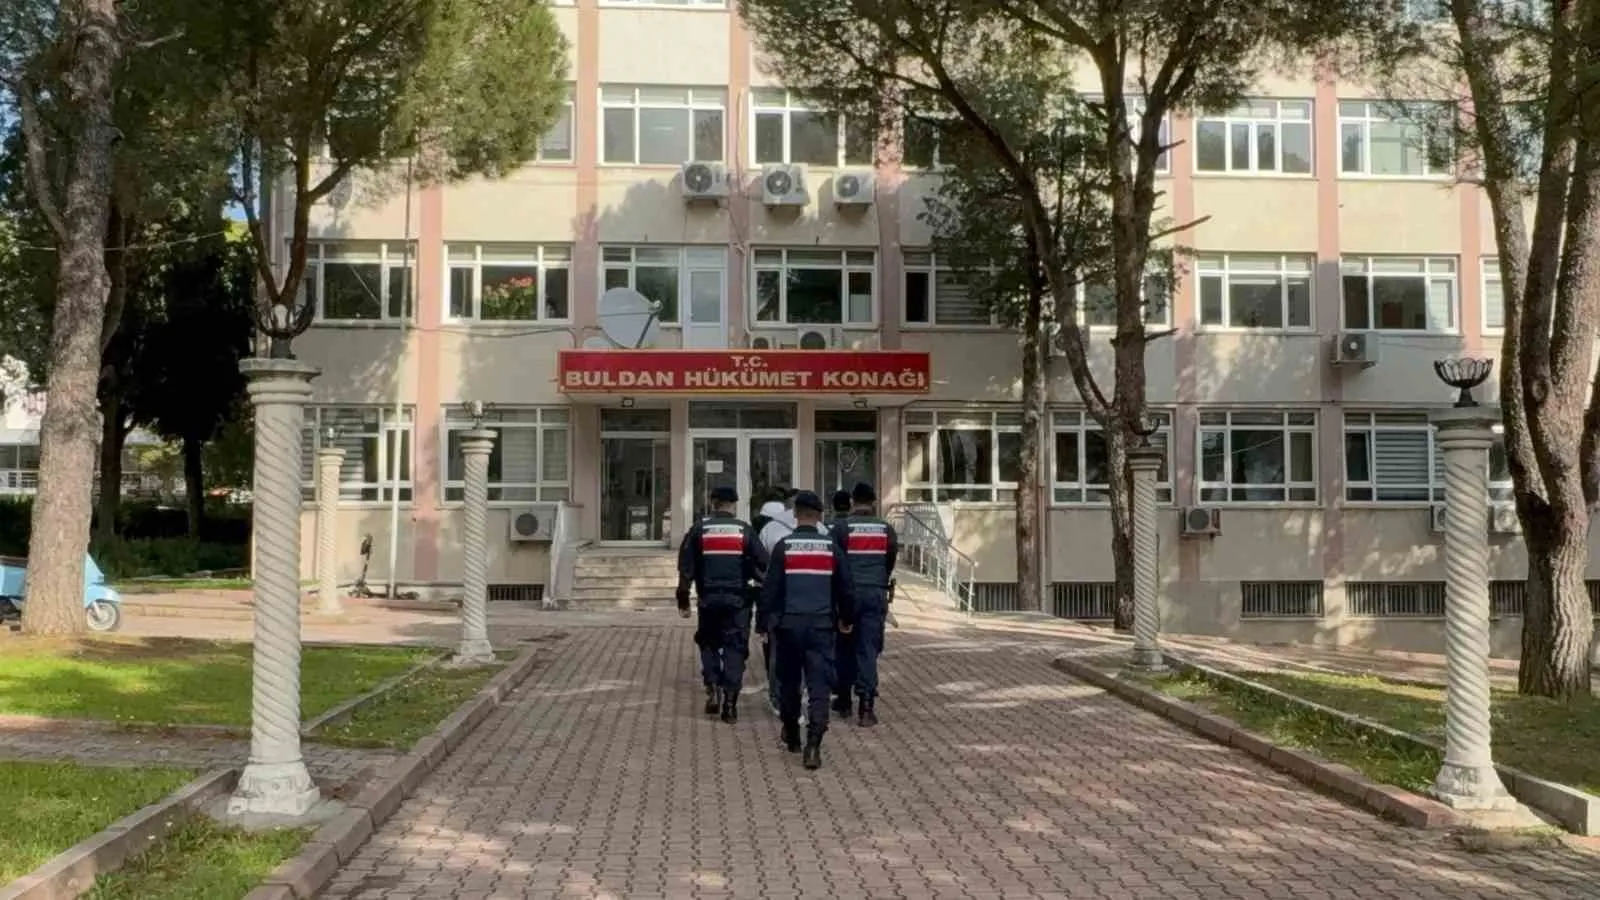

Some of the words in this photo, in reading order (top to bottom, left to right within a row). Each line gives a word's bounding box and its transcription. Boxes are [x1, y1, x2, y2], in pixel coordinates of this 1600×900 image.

[731, 355, 769, 368] T.C.
[565, 371, 675, 386] BULDAN
[684, 367, 812, 387] HÜKÜMET
[823, 368, 924, 387] KONAĞI
